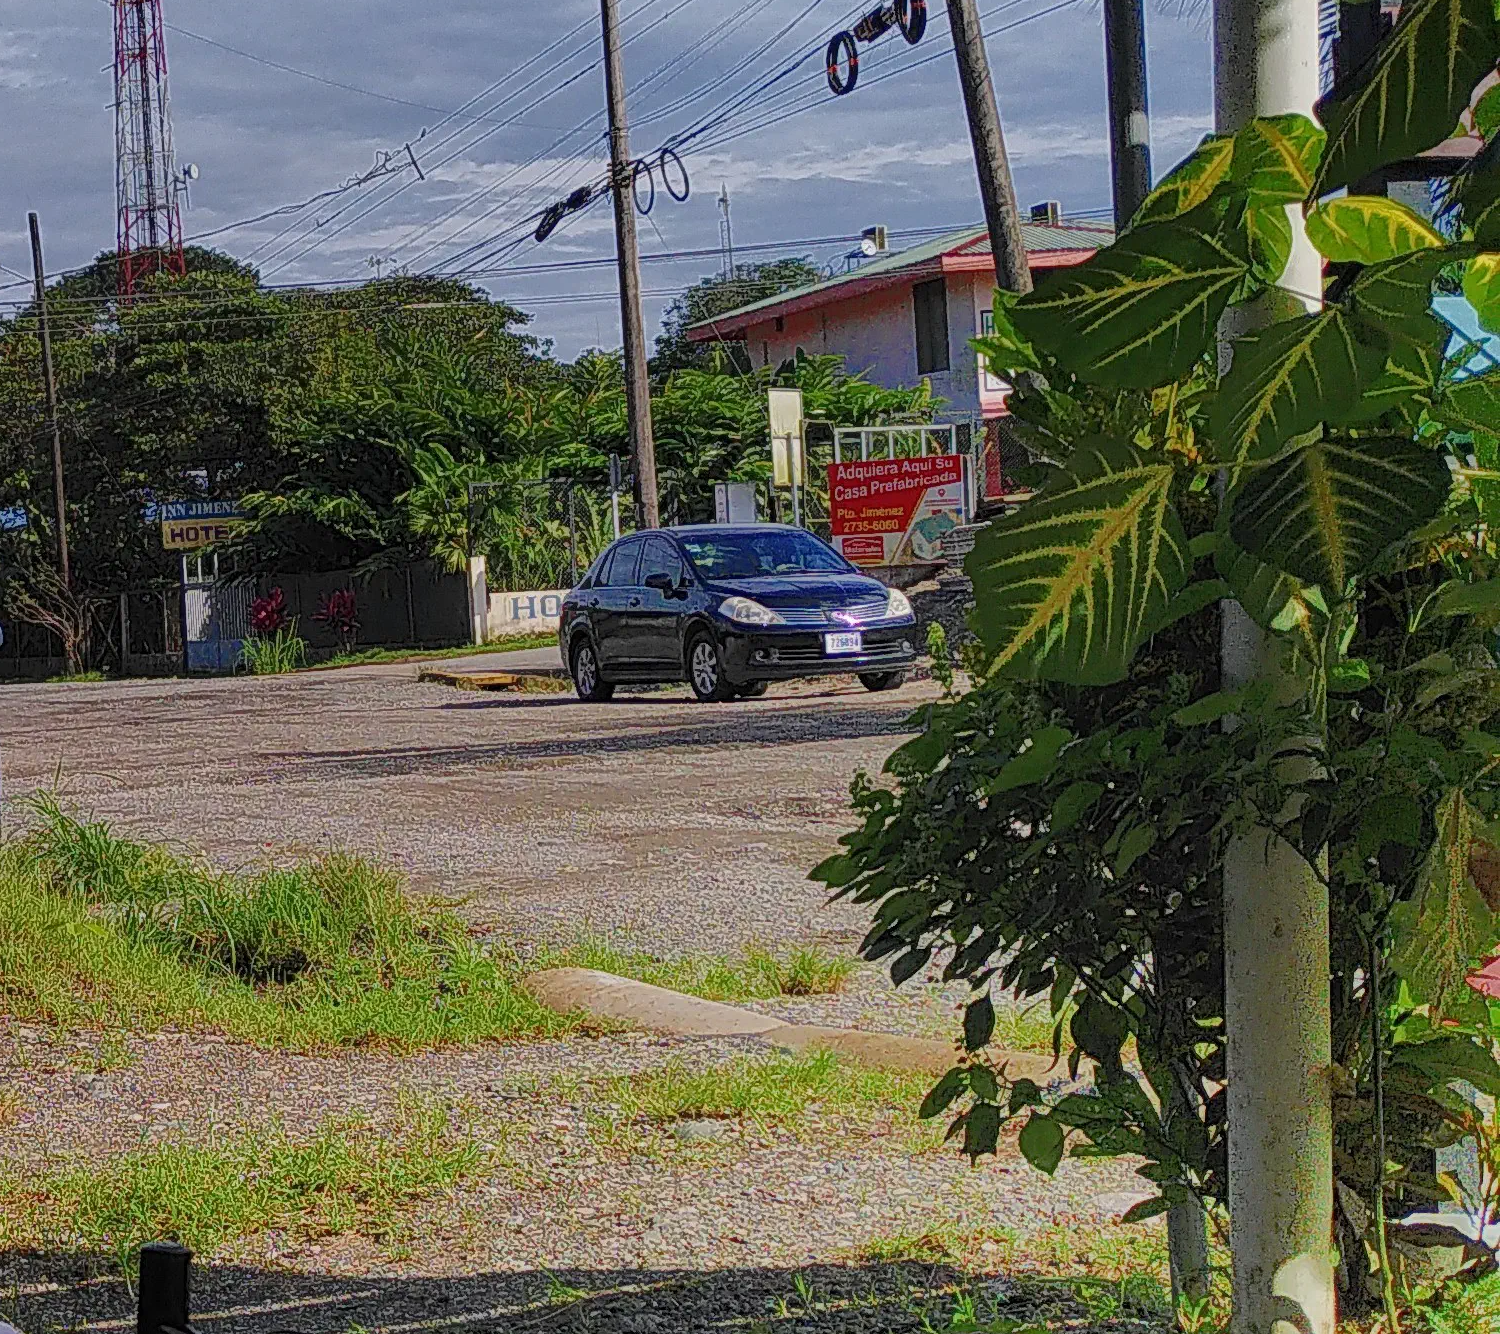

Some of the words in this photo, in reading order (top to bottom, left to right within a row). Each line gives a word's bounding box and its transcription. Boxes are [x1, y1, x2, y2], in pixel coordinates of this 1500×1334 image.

[836, 463, 899, 482] Adquiera
[901, 460, 932, 474] Aquí
[935, 458, 954, 469] Su
[834, 485, 868, 502] Casa
[870, 471, 957, 495] Prefabricada
[170, 524, 230, 543] HOTE
[511, 595, 561, 620] HO
